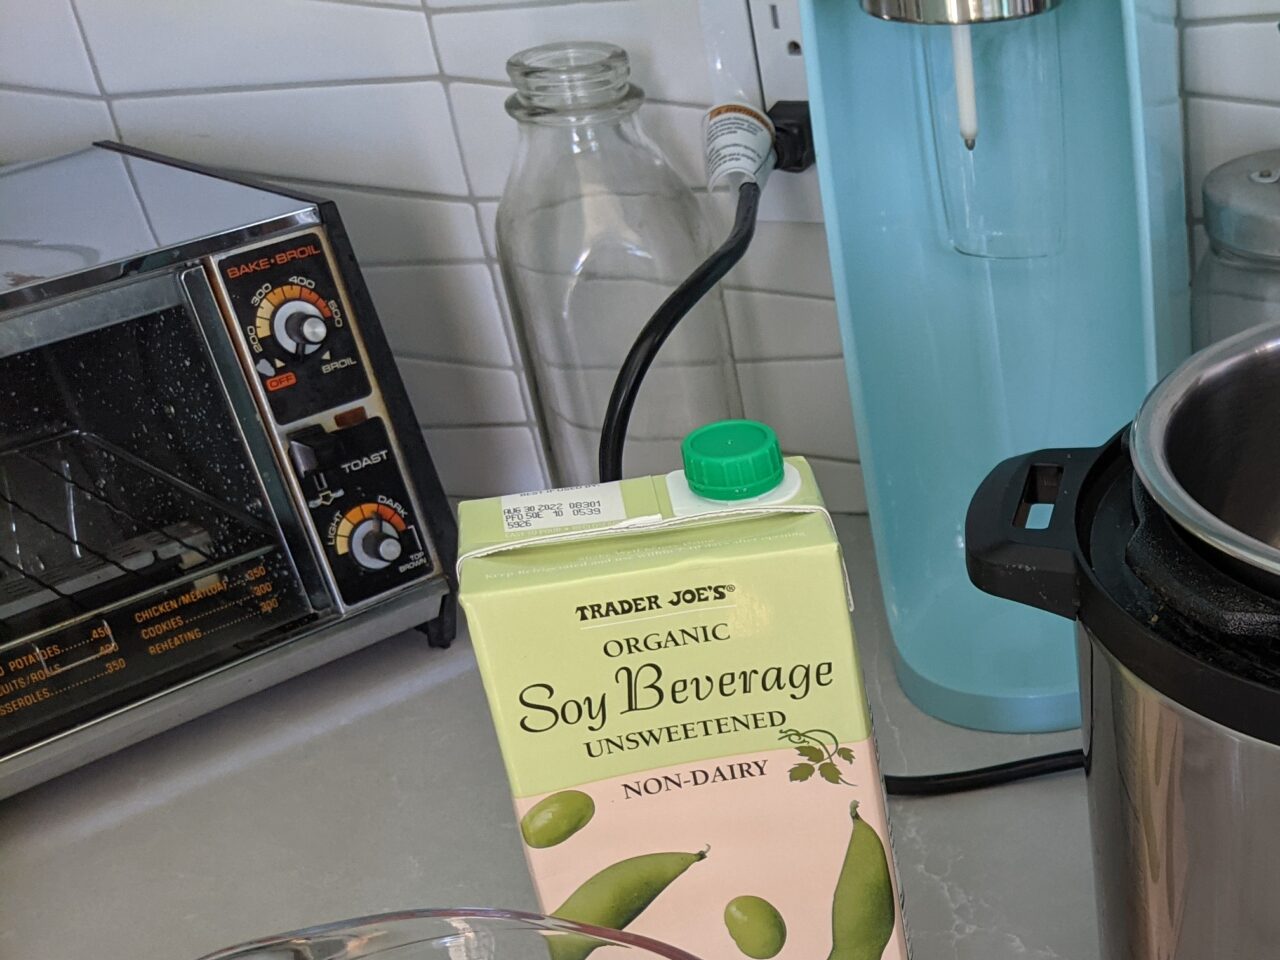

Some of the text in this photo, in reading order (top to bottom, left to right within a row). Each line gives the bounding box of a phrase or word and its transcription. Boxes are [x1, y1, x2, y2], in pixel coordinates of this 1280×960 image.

[227, 245, 321, 279] BAKE BROIL
[251, 283, 272, 307] 300
[289, 276, 315, 289] 400
[327, 300, 343, 328] 500
[247, 325, 263, 353] 200
[322, 357, 357, 374] BROIL
[269, 374, 295, 388] OFF
[341, 450, 388, 473] TOAST
[378, 495, 408, 518] DARK
[523, 505, 536, 513] 30
[538, 502, 563, 512] 2022
[327, 510, 344, 545] LIGHT
[398, 557, 427, 573] BROWN
[410, 551, 425, 561] TOP
[141, 582, 273, 640] COOKIES 300
[575, 584, 727, 622] TRADER JOE'S
[148, 628, 203, 656] REHEATING
[602, 622, 731, 658] ORGANIC
[8, 644, 61, 672] POTATOES
[518, 660, 834, 733] Soy Beverage
[584, 710, 787, 758] UNSWEETENED
[621, 759, 769, 800] NON-DAIRY
